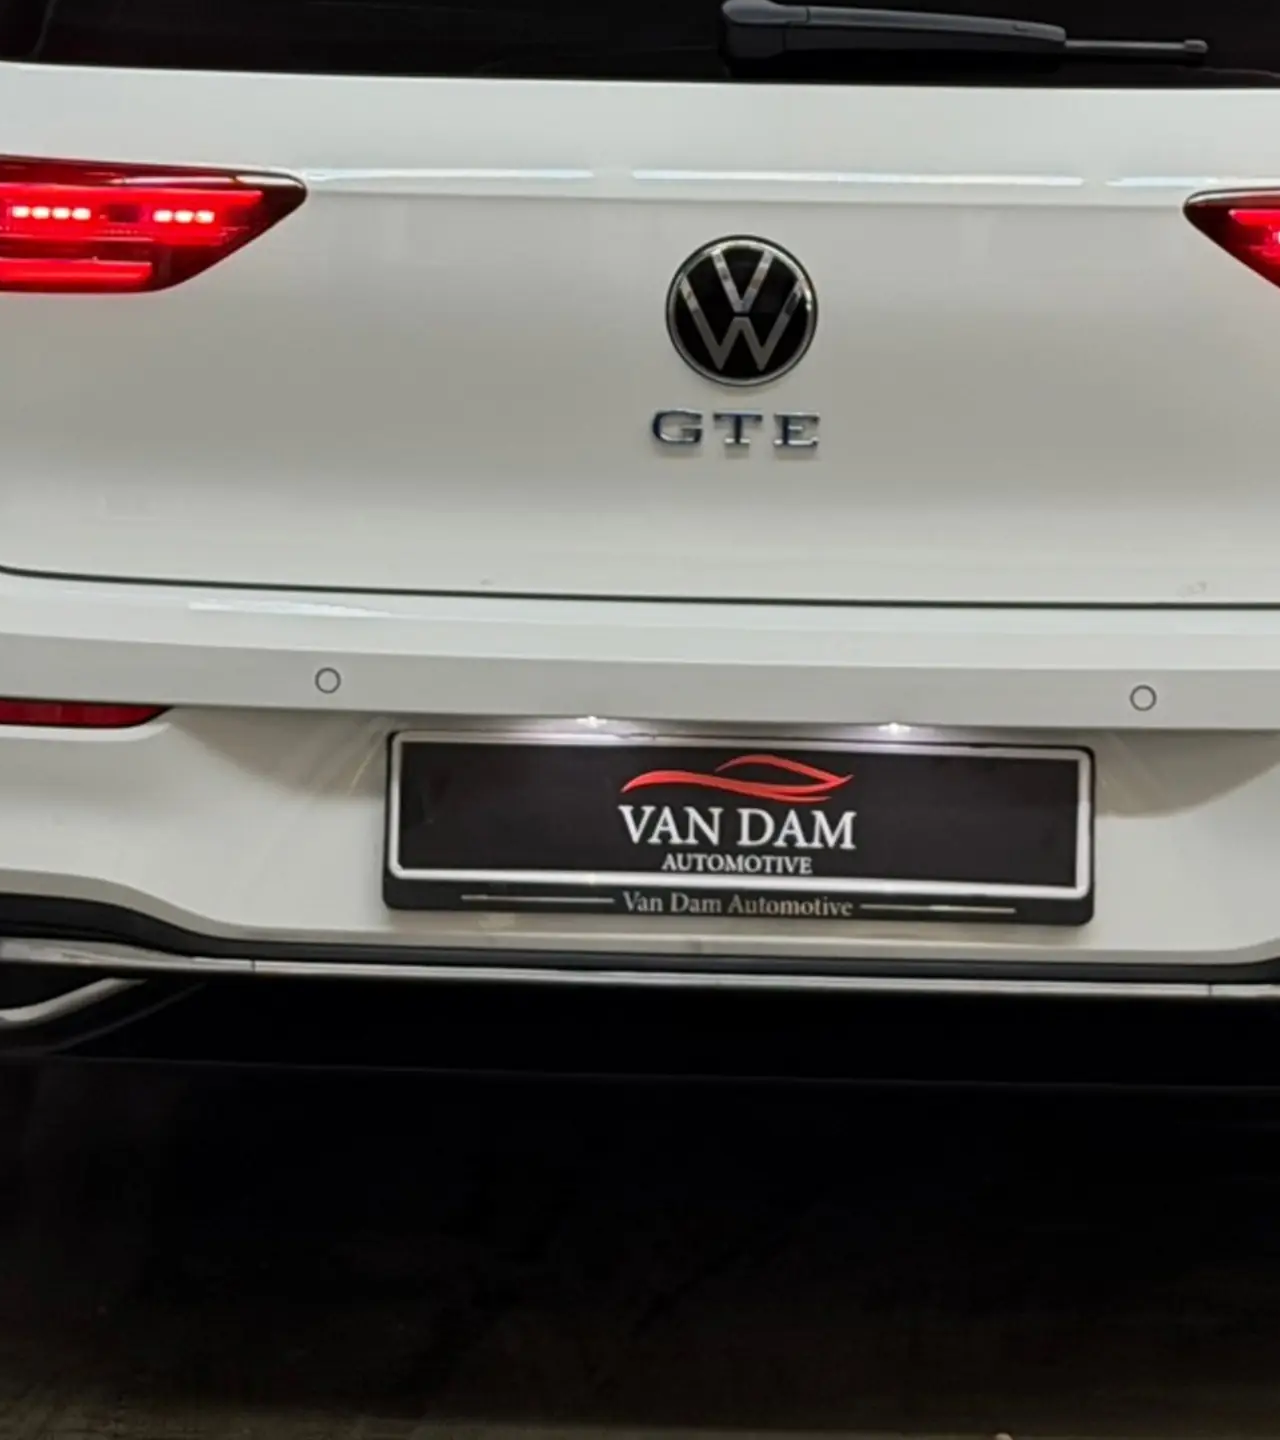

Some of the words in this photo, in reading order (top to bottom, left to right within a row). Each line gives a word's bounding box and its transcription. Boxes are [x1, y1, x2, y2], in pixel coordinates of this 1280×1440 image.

[652, 409, 820, 447] GTE
[618, 805, 723, 846] VAN
[736, 808, 857, 850] DAM
[661, 853, 813, 875] AUTOMOTIVE
[623, 891, 663, 914] Van
[670, 892, 722, 916] Dam
[727, 893, 853, 918] Automotive
